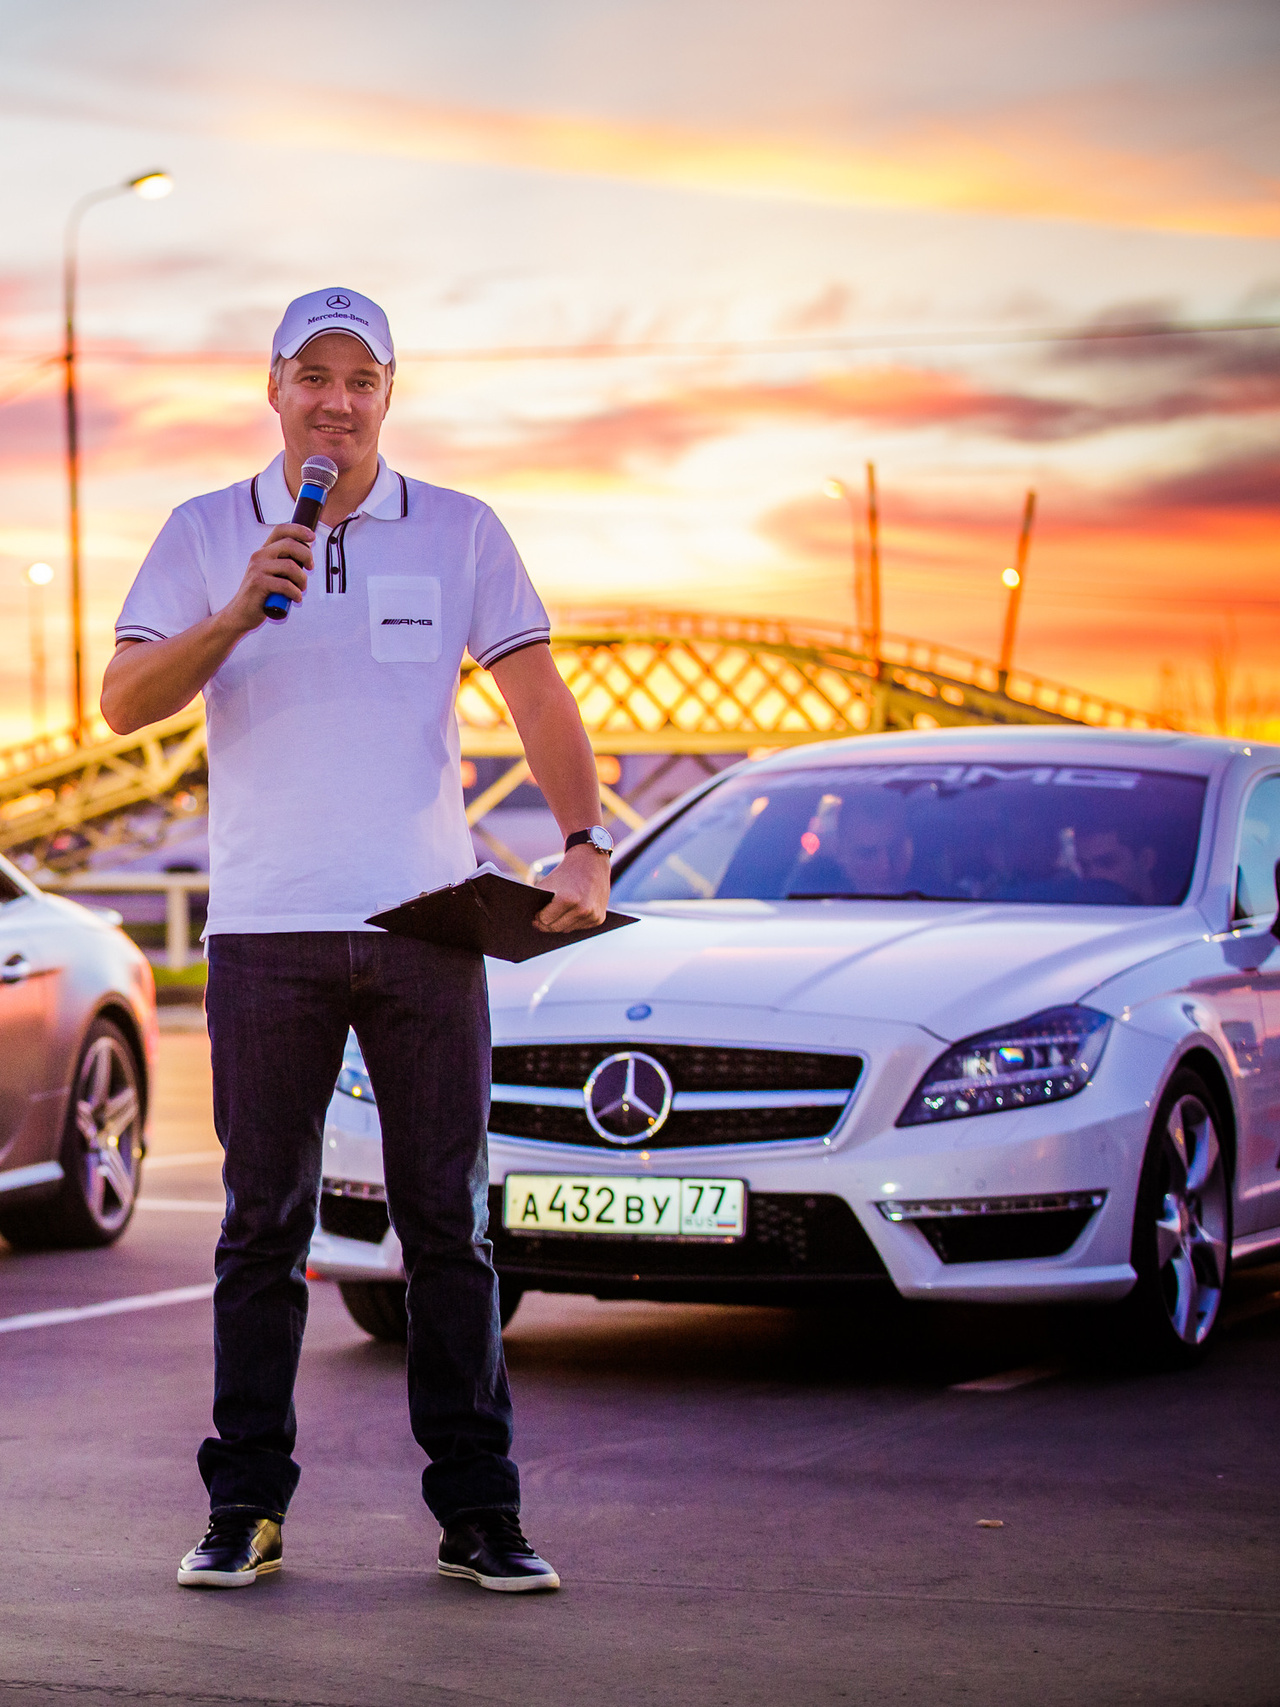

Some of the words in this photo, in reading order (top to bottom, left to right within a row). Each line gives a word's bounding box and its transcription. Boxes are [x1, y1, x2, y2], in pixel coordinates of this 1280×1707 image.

[307, 311, 369, 326] Mercedes-Benz
[397, 618, 433, 626] AMG
[688, 1185, 726, 1215] 77
